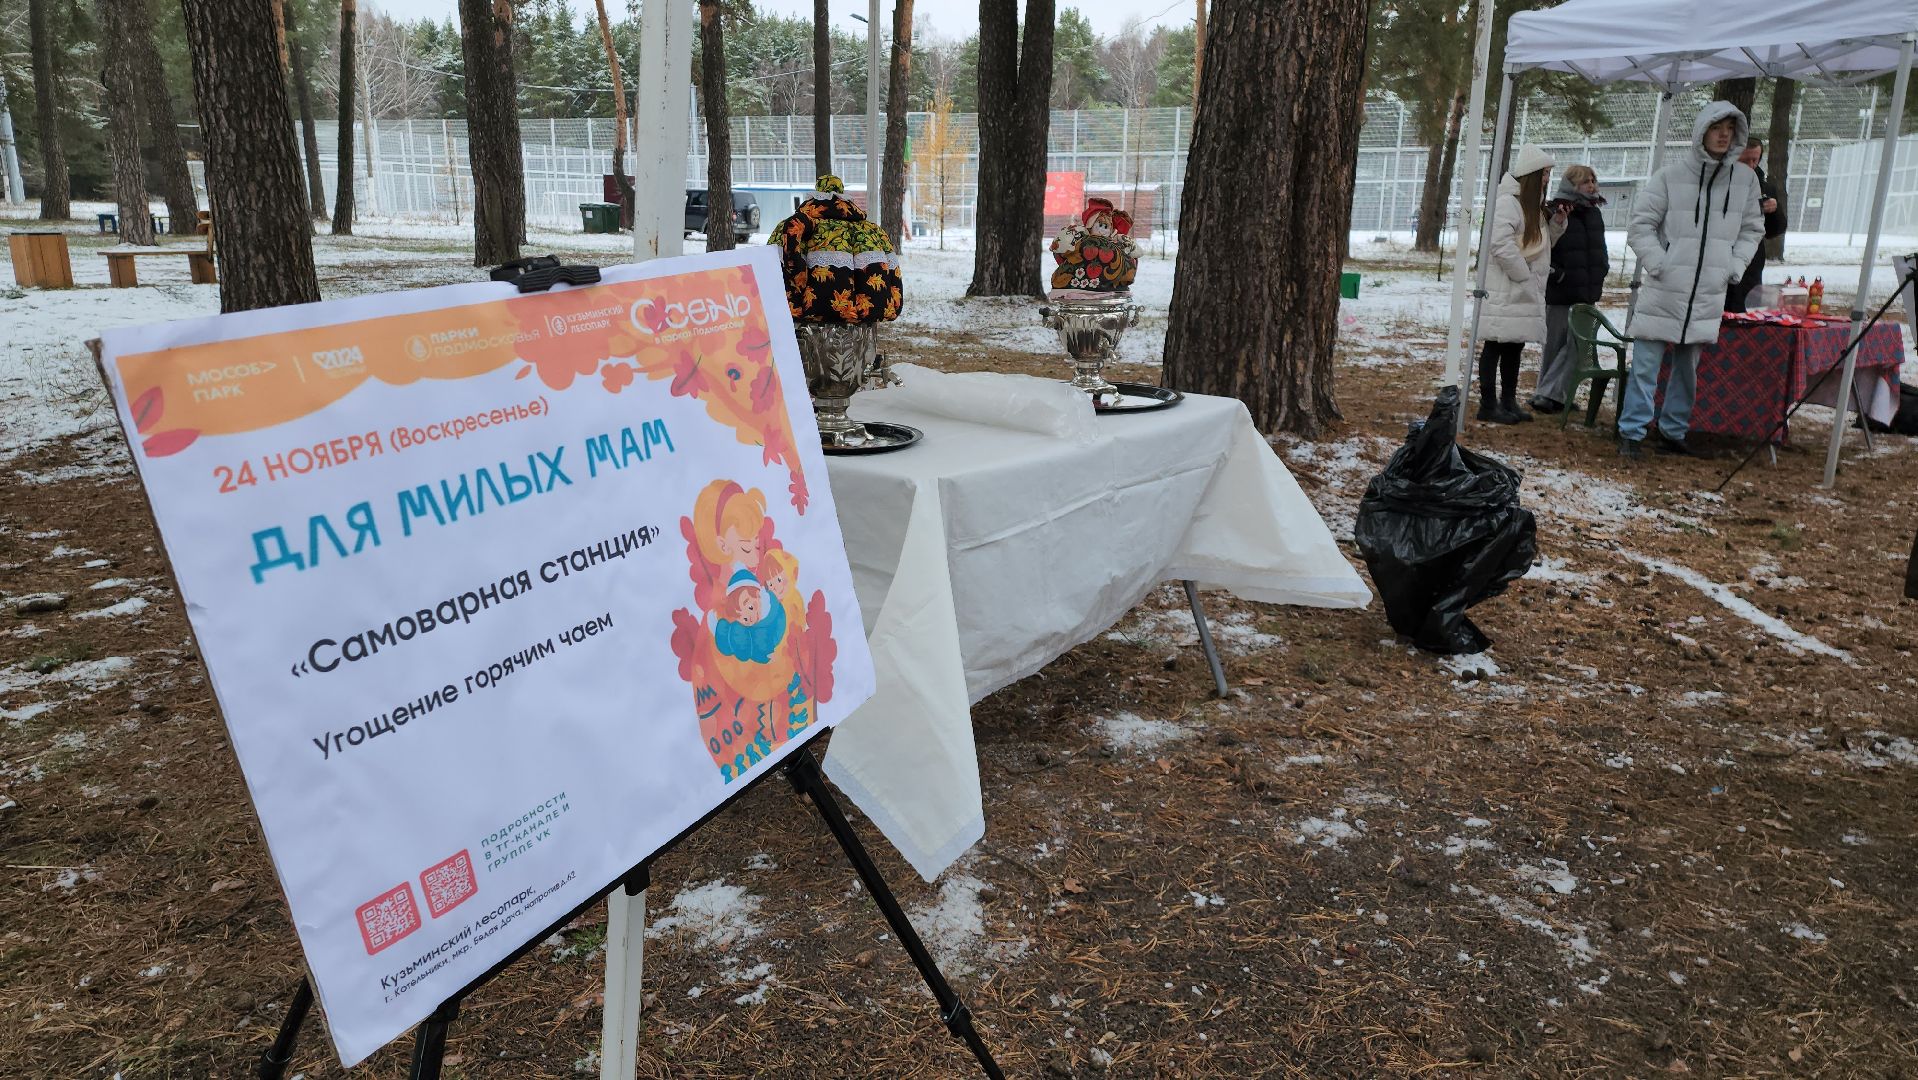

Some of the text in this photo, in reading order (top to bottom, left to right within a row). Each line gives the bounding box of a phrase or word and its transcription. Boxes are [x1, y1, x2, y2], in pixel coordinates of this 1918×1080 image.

[430, 327, 479, 344] ПАРКИ
[193, 384, 245, 402] ПАРК
[214, 396, 549, 494] 24 НОЯБРЯ (Воскресенье)
[250, 418, 675, 584] ДЛЯ МИЛЫХ МАМ
[291, 523, 660, 678] «Самоварная станция»
[312, 612, 613, 760] Угощение горячим чаем
[481, 791, 567, 848] ПОДРОБНОСТИ
[484, 802, 571, 861] В ТГ-КАНАЛЕ И
[487, 839, 534, 872] ГРУППЕ
[380, 884, 536, 990] Кузьминский лесопарк,
